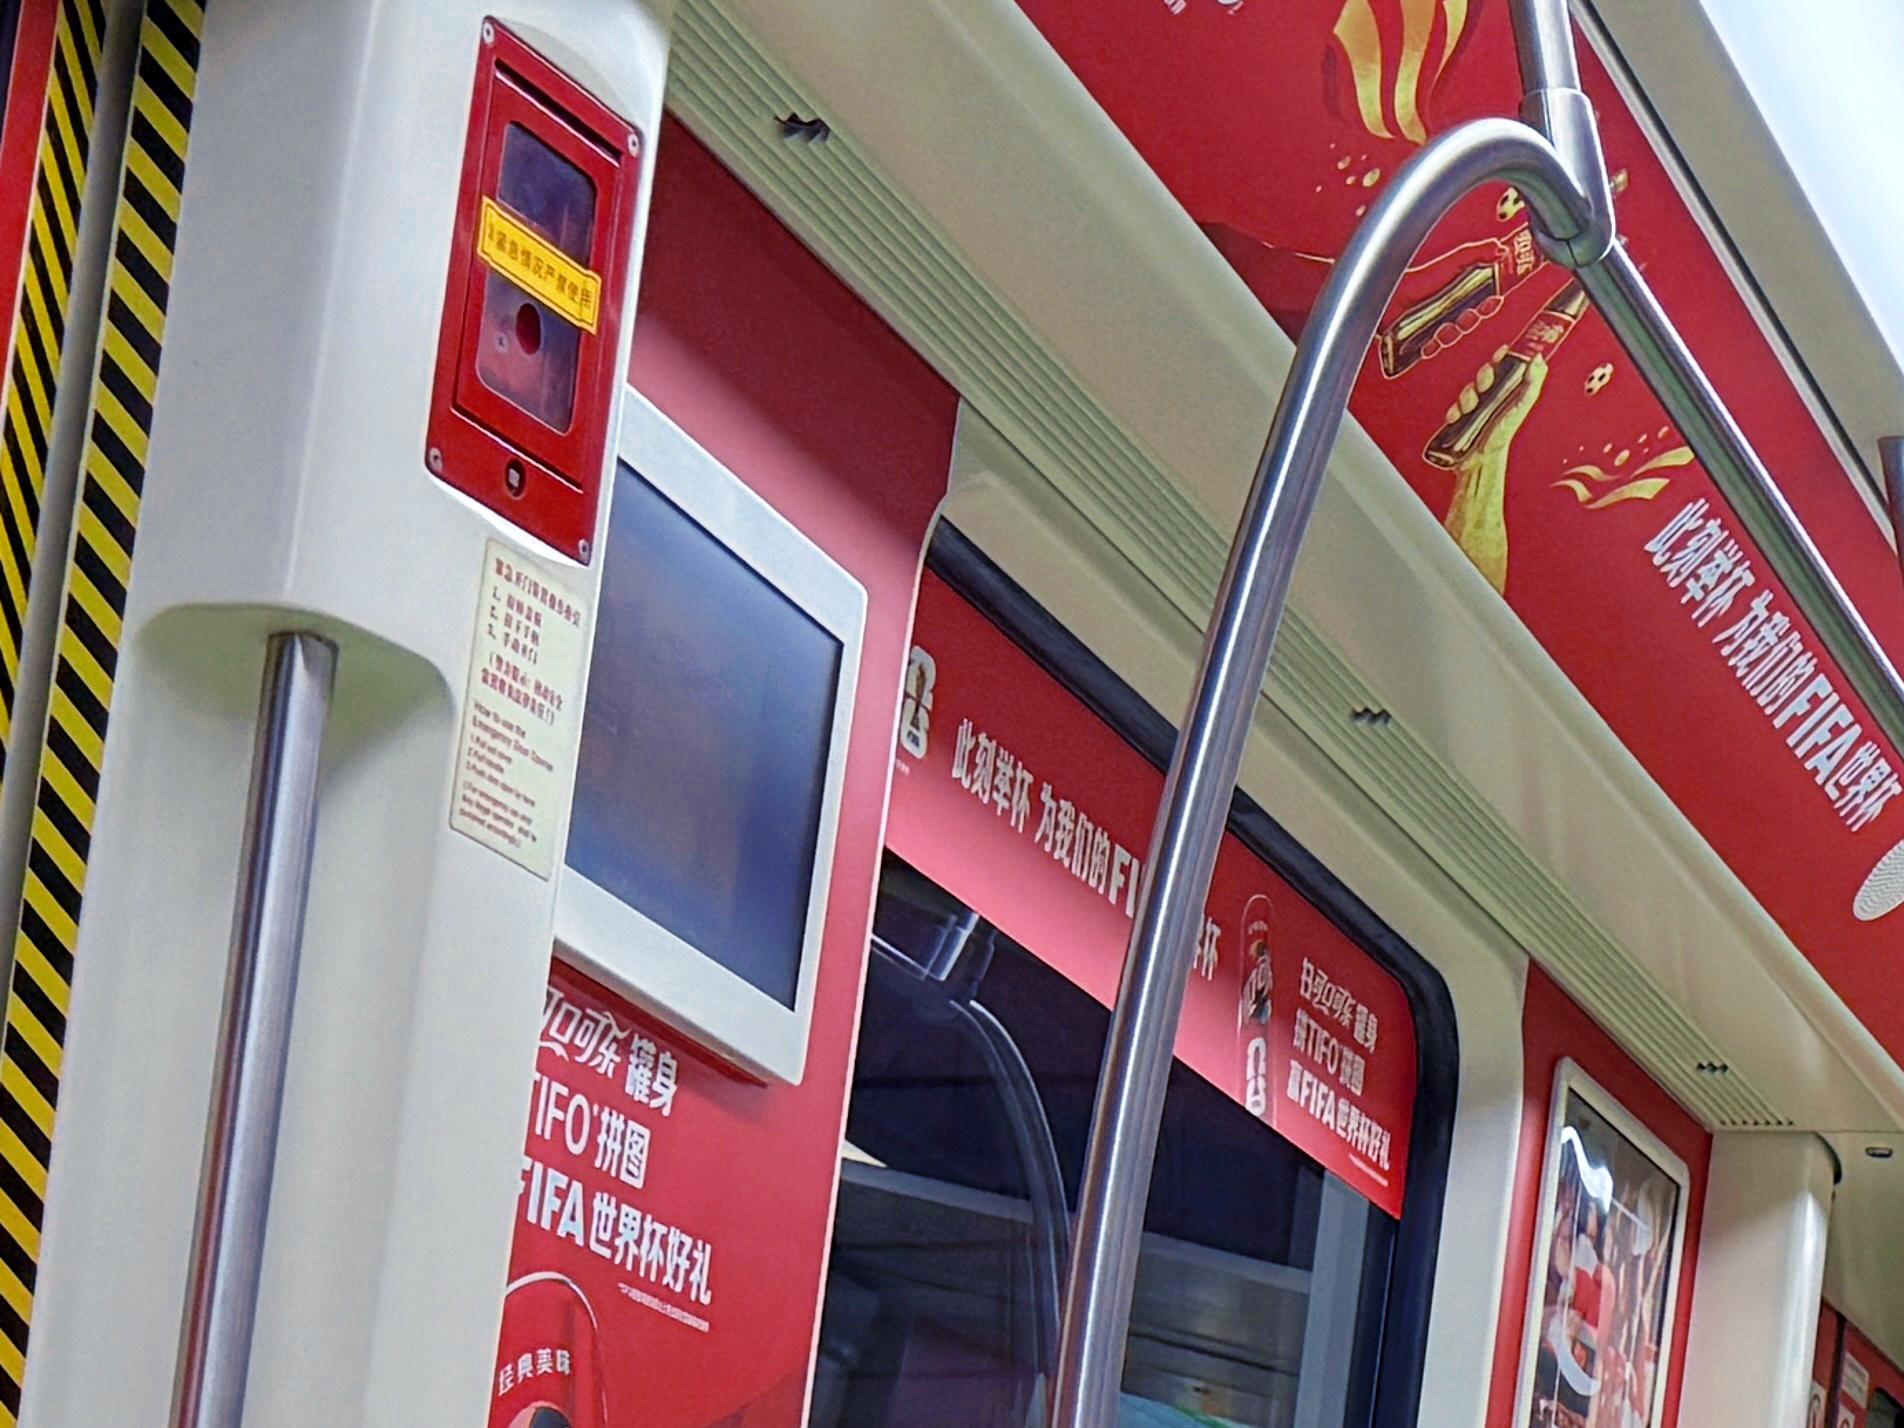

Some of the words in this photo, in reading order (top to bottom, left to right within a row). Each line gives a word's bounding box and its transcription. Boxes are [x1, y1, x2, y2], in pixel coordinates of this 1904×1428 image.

[951, 719, 1034, 834] 此刻举杯
[1644, 498, 1756, 628] 此刻举杯
[1712, 590, 1904, 833] 为我们的FIFA世界杯
